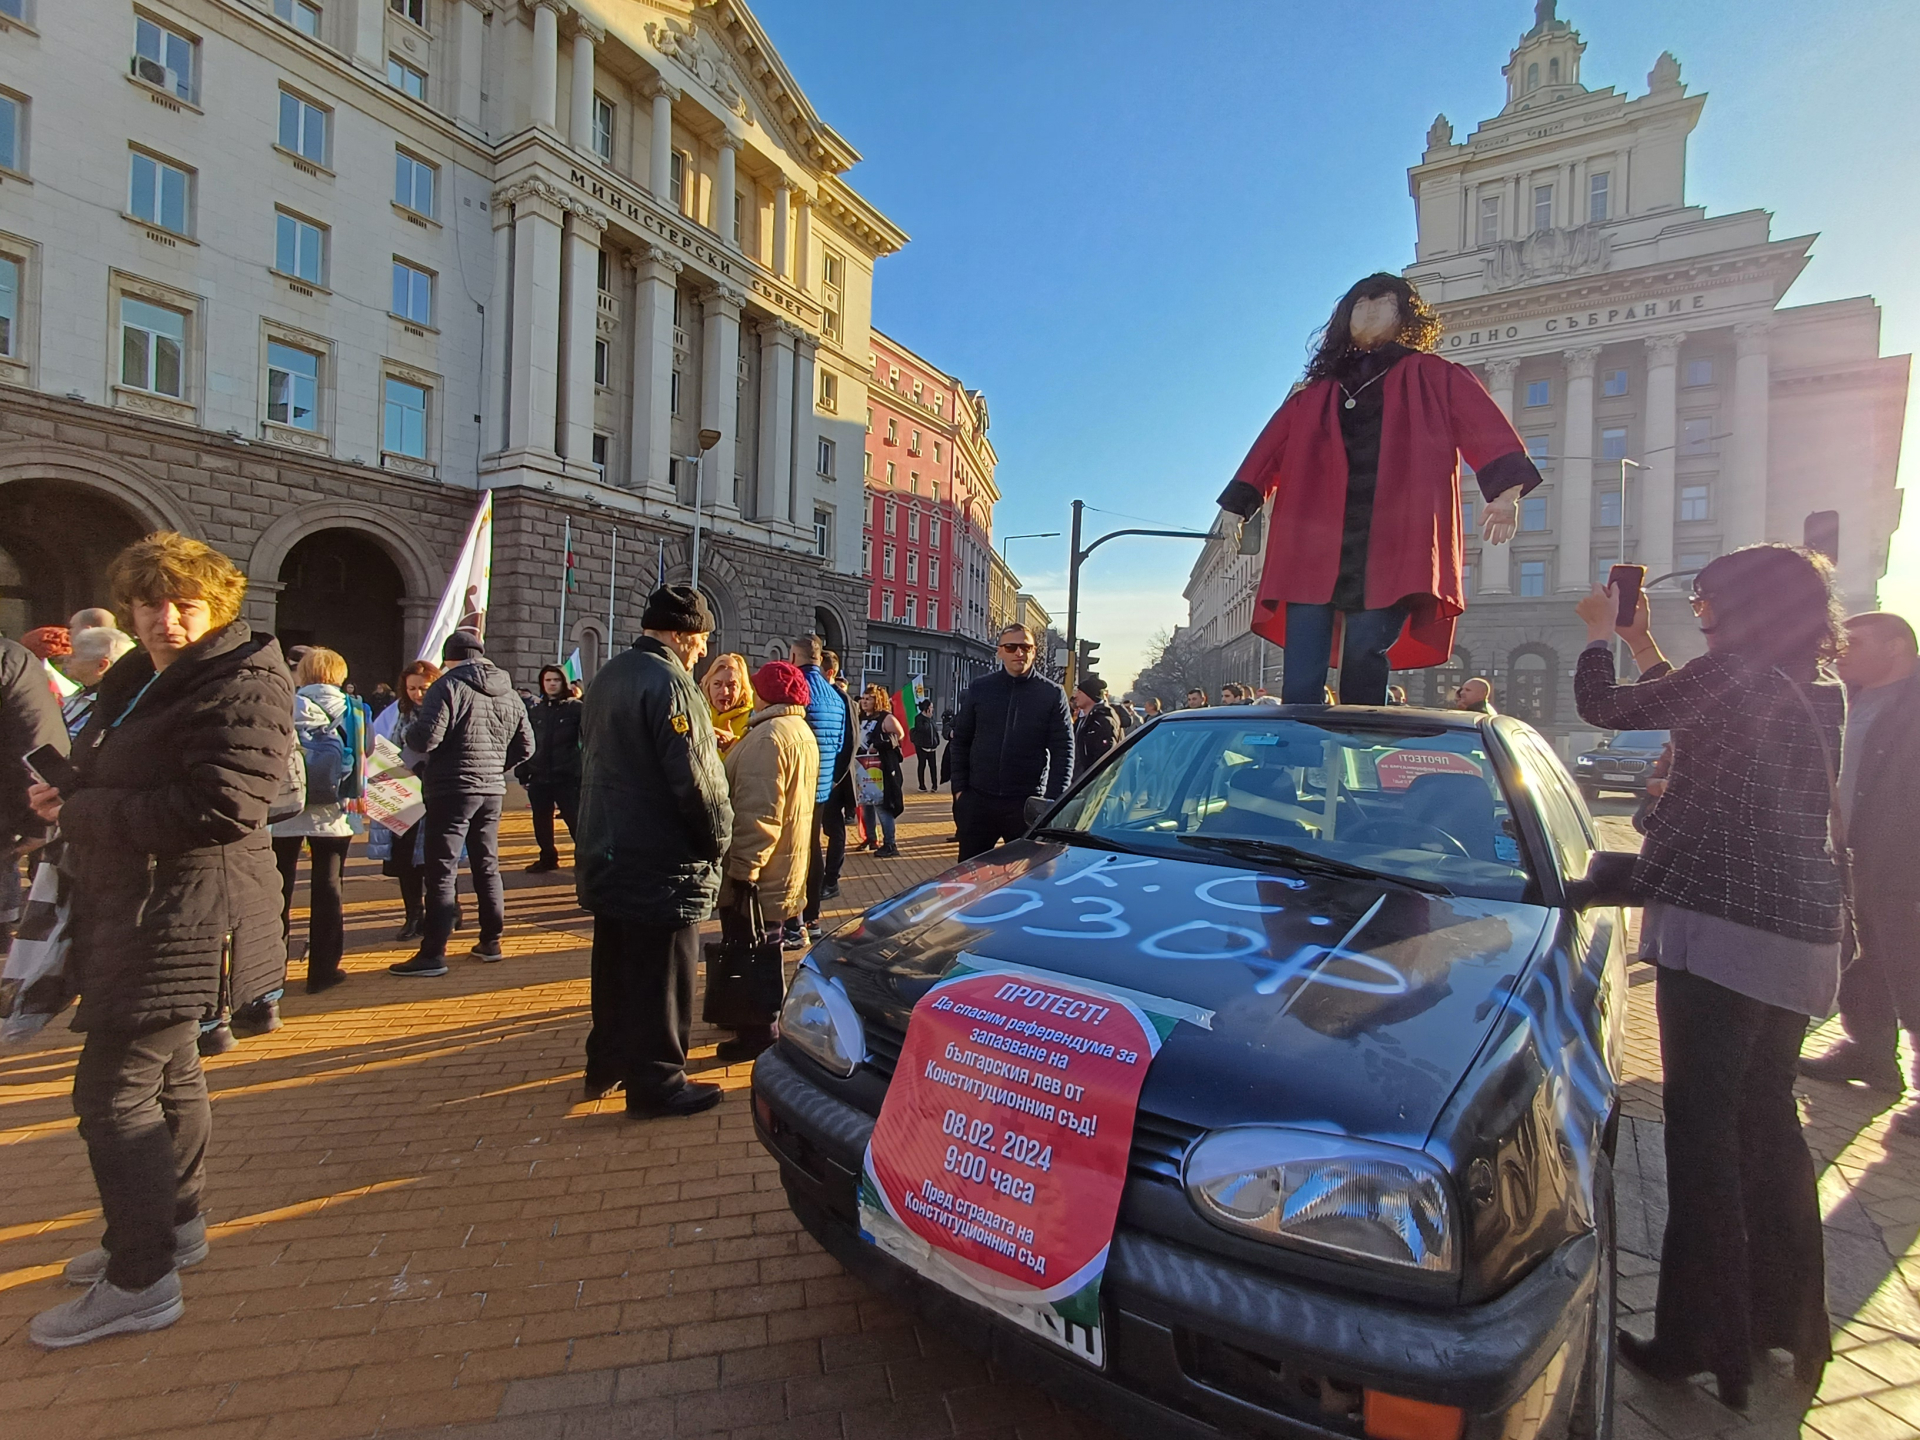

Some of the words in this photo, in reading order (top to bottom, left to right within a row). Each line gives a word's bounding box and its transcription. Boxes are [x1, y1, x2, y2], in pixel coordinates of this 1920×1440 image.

[570, 169, 731, 275] МИНИСТЕРСКИ
[751, 279, 803, 316] СЪВЕТ
[1434, 326, 1518, 350] РОДНО
[1545, 295, 1704, 333] СЪБРАНИЕ
[932, 995, 951, 1012] Да
[953, 1003, 1005, 1027] спасим
[1004, 1017, 1116, 1058] референдума
[1118, 1048, 1138, 1064] за
[994, 982, 1110, 1026] ПРОТЕСТ!
[945, 1042, 1029, 1084] българския
[1031, 1072, 1062, 1093] лев
[1064, 1082, 1085, 1102] от
[969, 1028, 1046, 1061] запазване
[1049, 1050, 1069, 1069] на
[924, 1059, 1055, 1121] Конституционния
[1057, 1111, 1097, 1137] съд!
[942, 1109, 996, 1153] 08.02.
[1000, 1131, 1053, 1172] 2024
[943, 1145, 986, 1183] 9:00
[989, 1167, 1035, 1205] часа
[904, 1190, 1016, 1257] Конституционния
[1018, 1246, 1046, 1275] съд
[921, 1178, 953, 1209] Пред
[955, 1197, 1016, 1236] сградата
[1017, 1225, 1034, 1245] на
